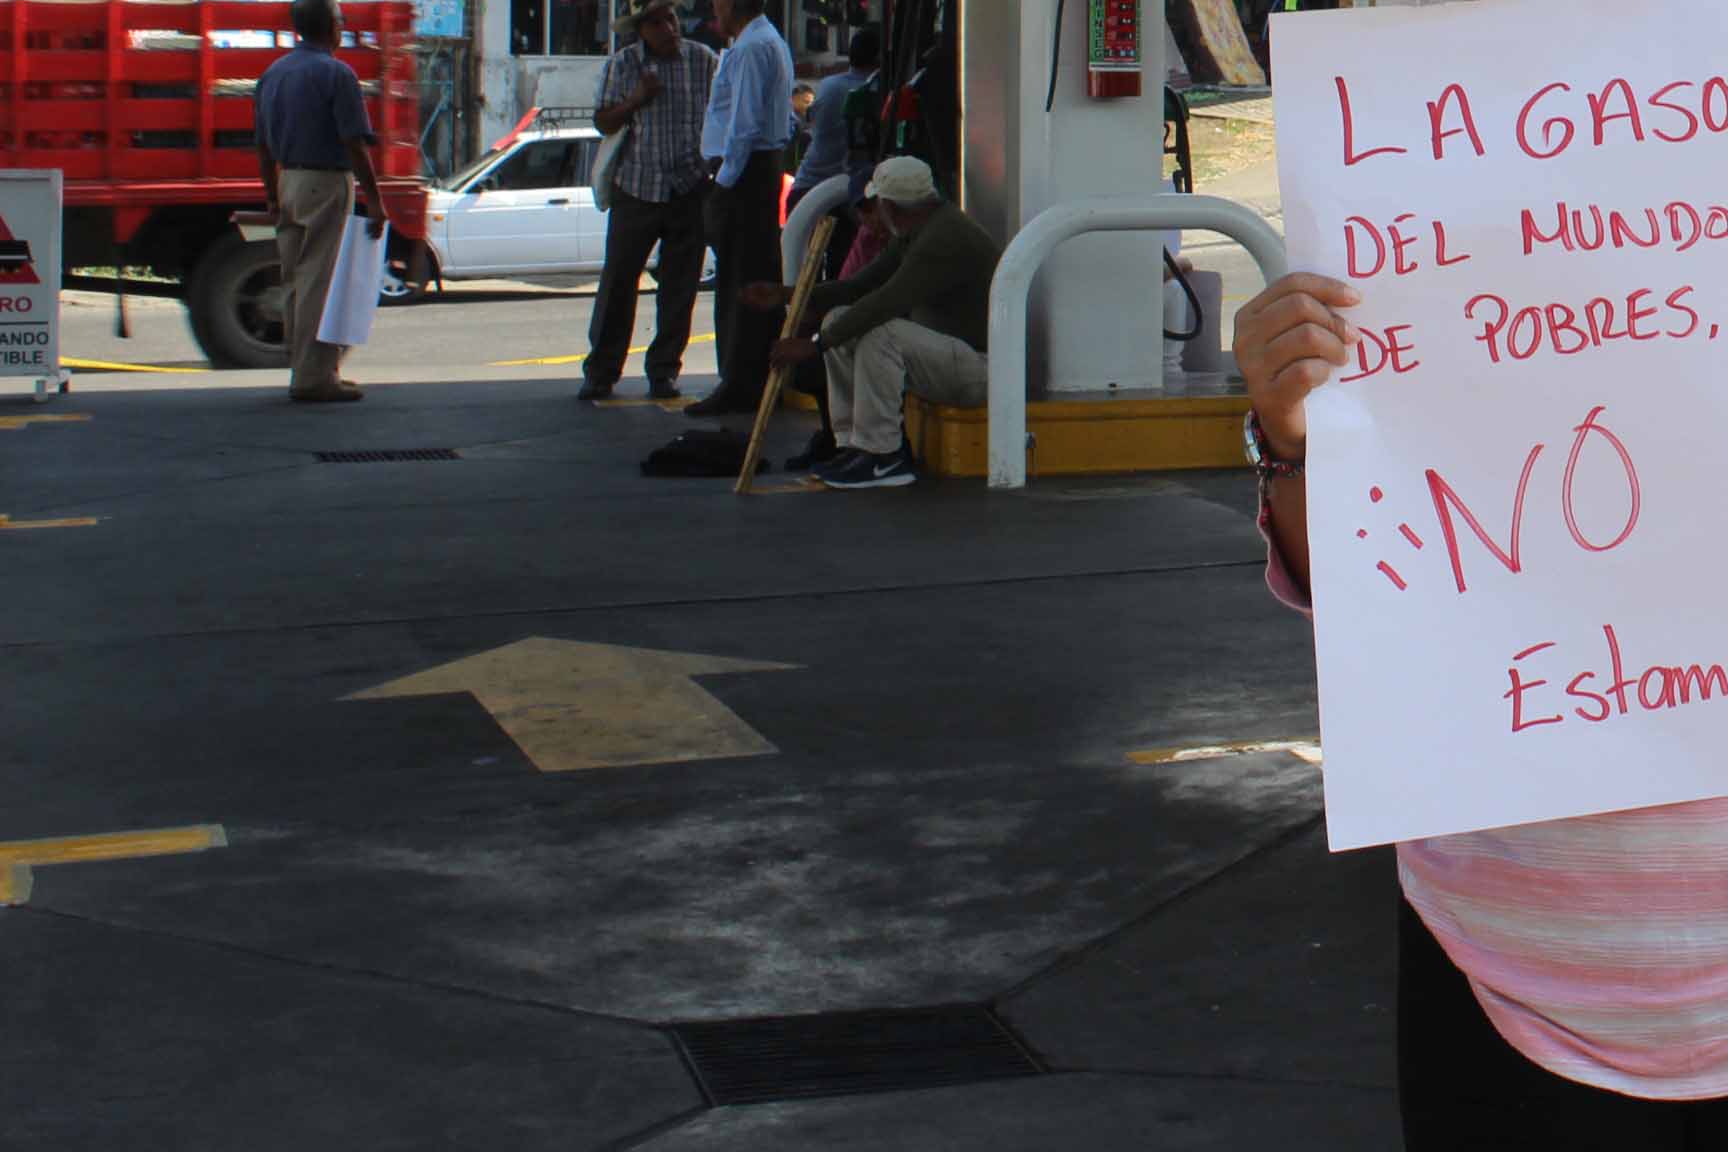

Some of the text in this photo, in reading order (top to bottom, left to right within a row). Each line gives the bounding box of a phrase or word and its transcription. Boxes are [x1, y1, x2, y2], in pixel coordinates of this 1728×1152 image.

[1334, 75, 1485, 166] LA
[1344, 213, 1471, 278] DEL
[1340, 323, 1420, 383] DE
[1464, 285, 1719, 363] POBRES,
